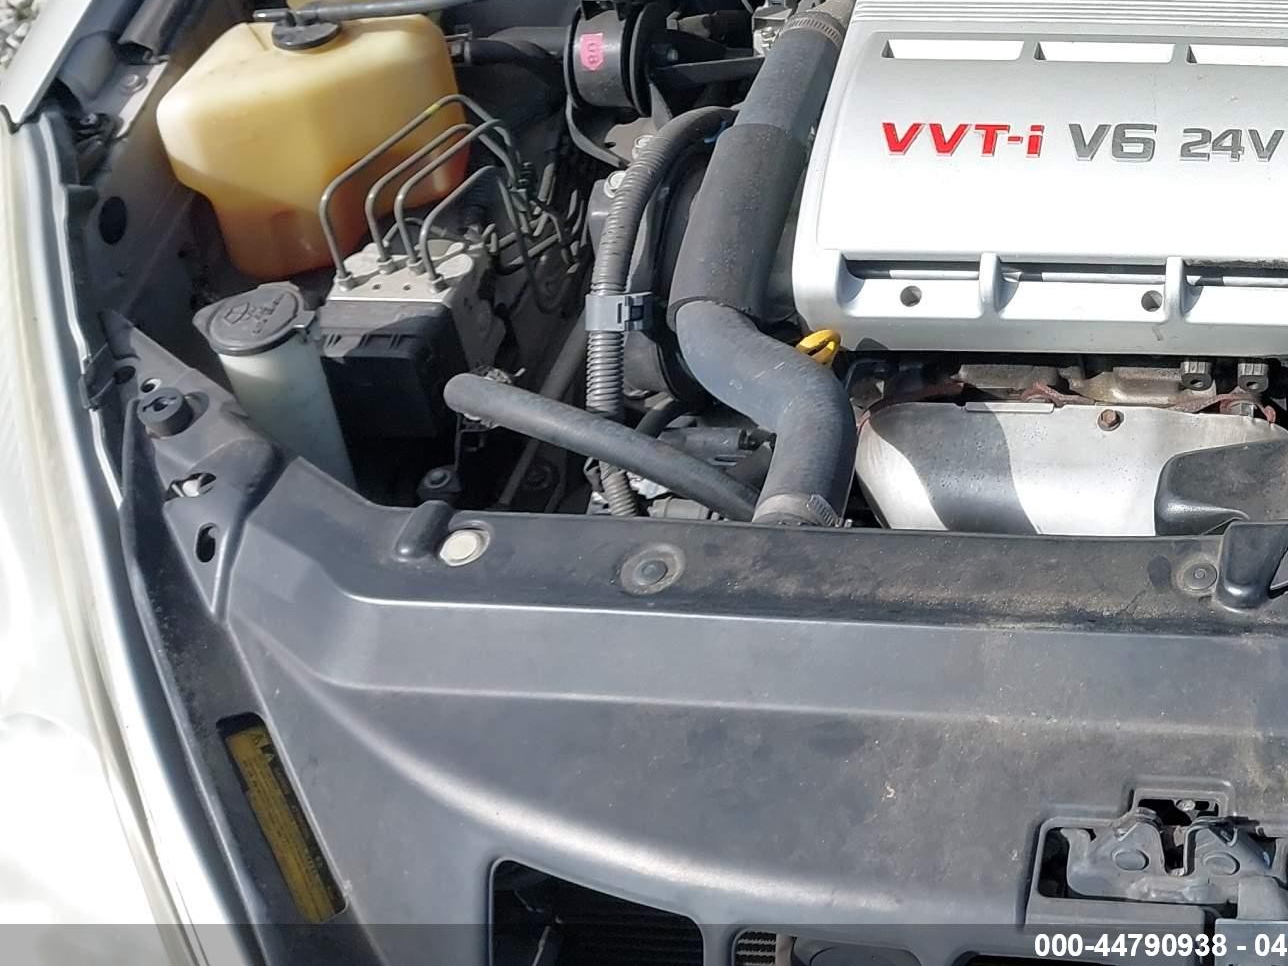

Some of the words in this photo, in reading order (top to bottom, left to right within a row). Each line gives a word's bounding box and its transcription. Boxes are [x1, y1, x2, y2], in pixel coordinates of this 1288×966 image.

[882, 122, 1047, 159] VVT-i
[1068, 123, 1158, 162] V6
[1179, 128, 1286, 162] 24V
